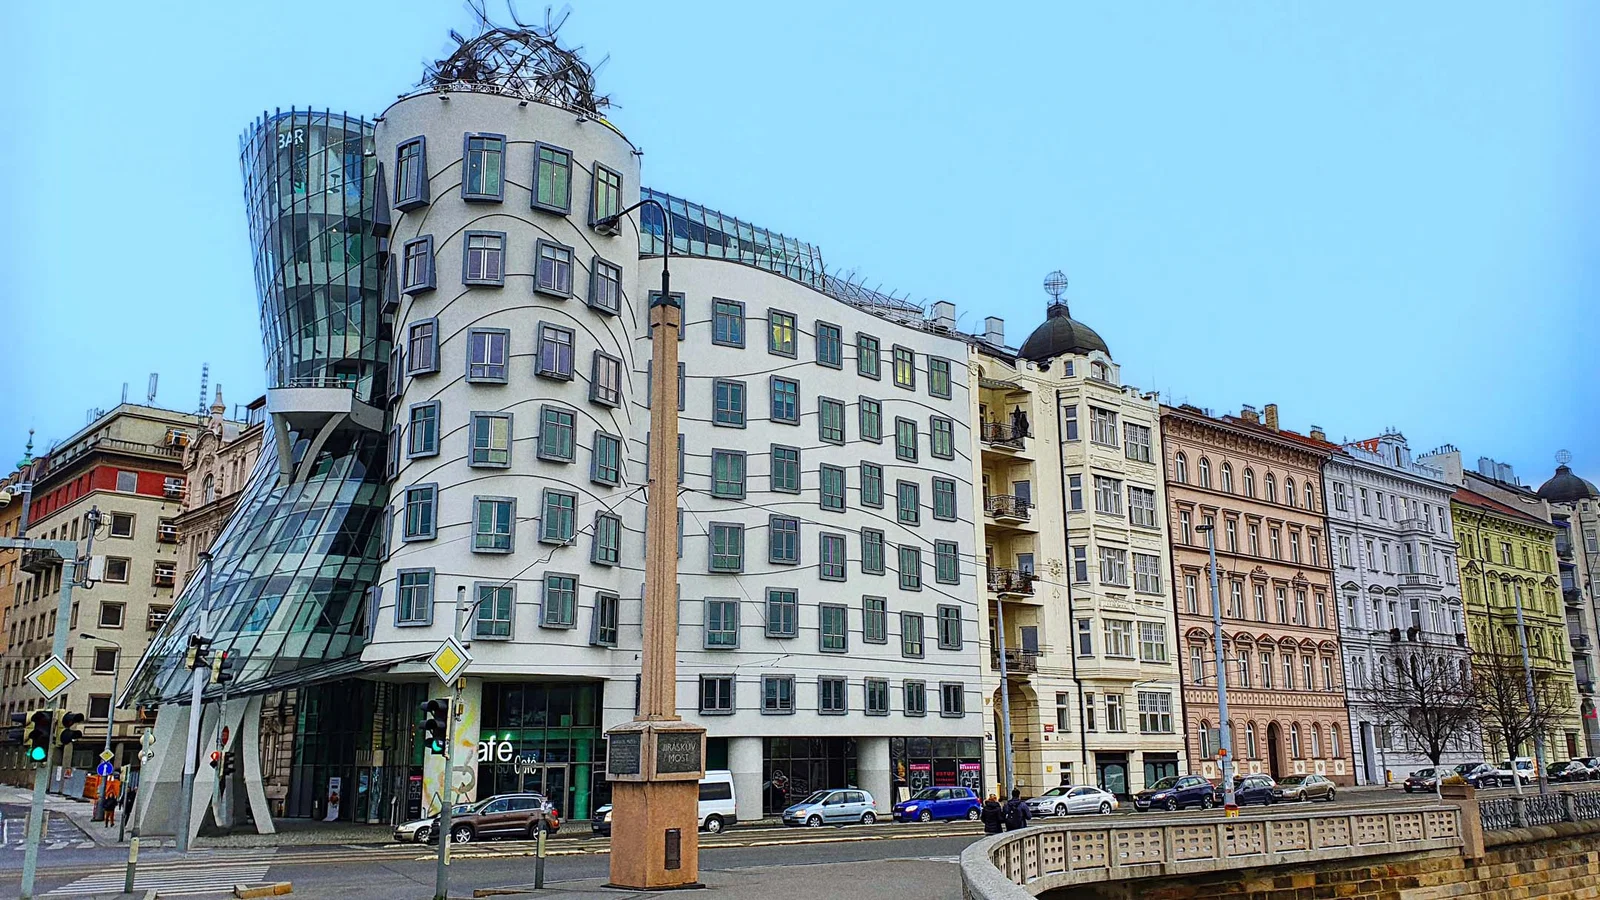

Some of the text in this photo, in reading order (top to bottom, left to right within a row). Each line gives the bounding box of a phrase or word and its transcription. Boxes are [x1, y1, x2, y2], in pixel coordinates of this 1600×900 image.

[278, 128, 304, 149] BAR
[478, 733, 513, 762] afé
[668, 753, 689, 763] MOST
